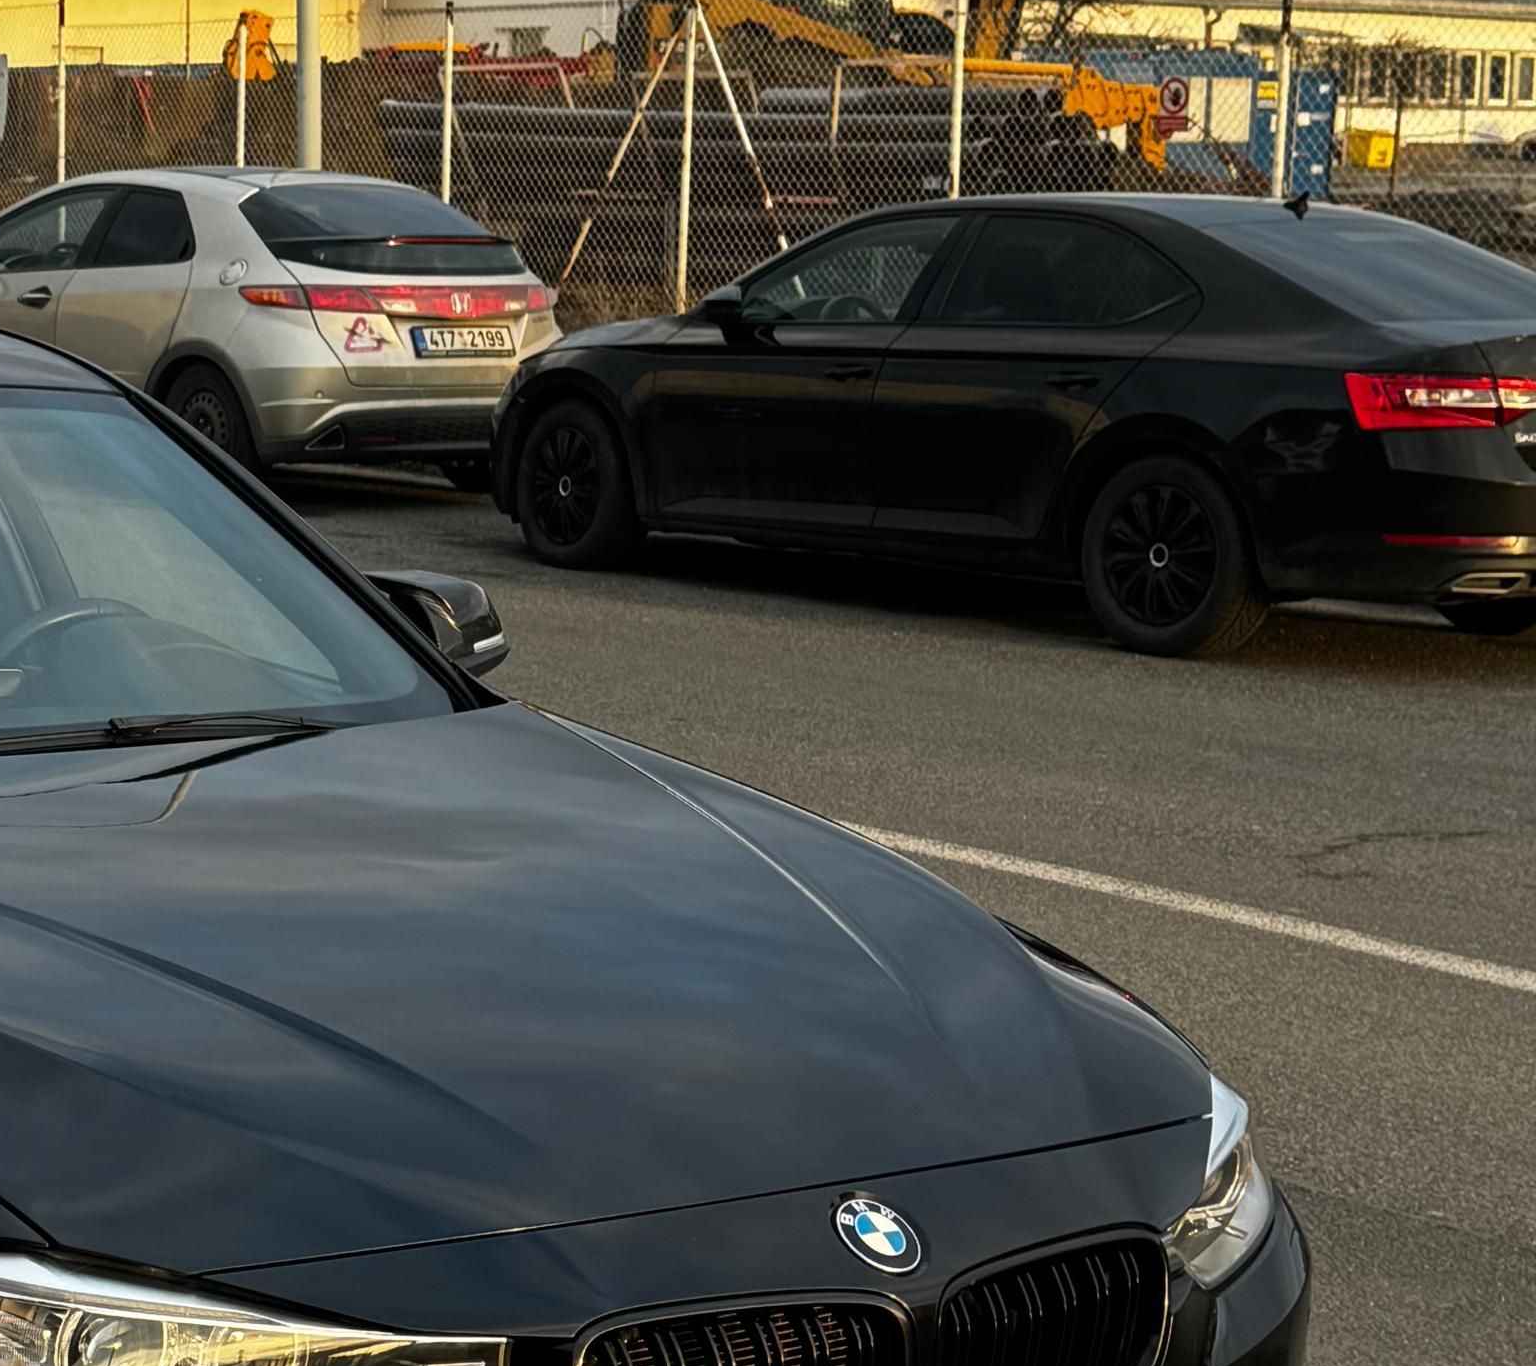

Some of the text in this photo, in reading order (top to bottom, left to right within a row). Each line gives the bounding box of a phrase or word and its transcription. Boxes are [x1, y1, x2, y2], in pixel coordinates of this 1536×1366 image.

[430, 330, 505, 347] 4T7 2199
[840, 1201, 896, 1226] BMW
